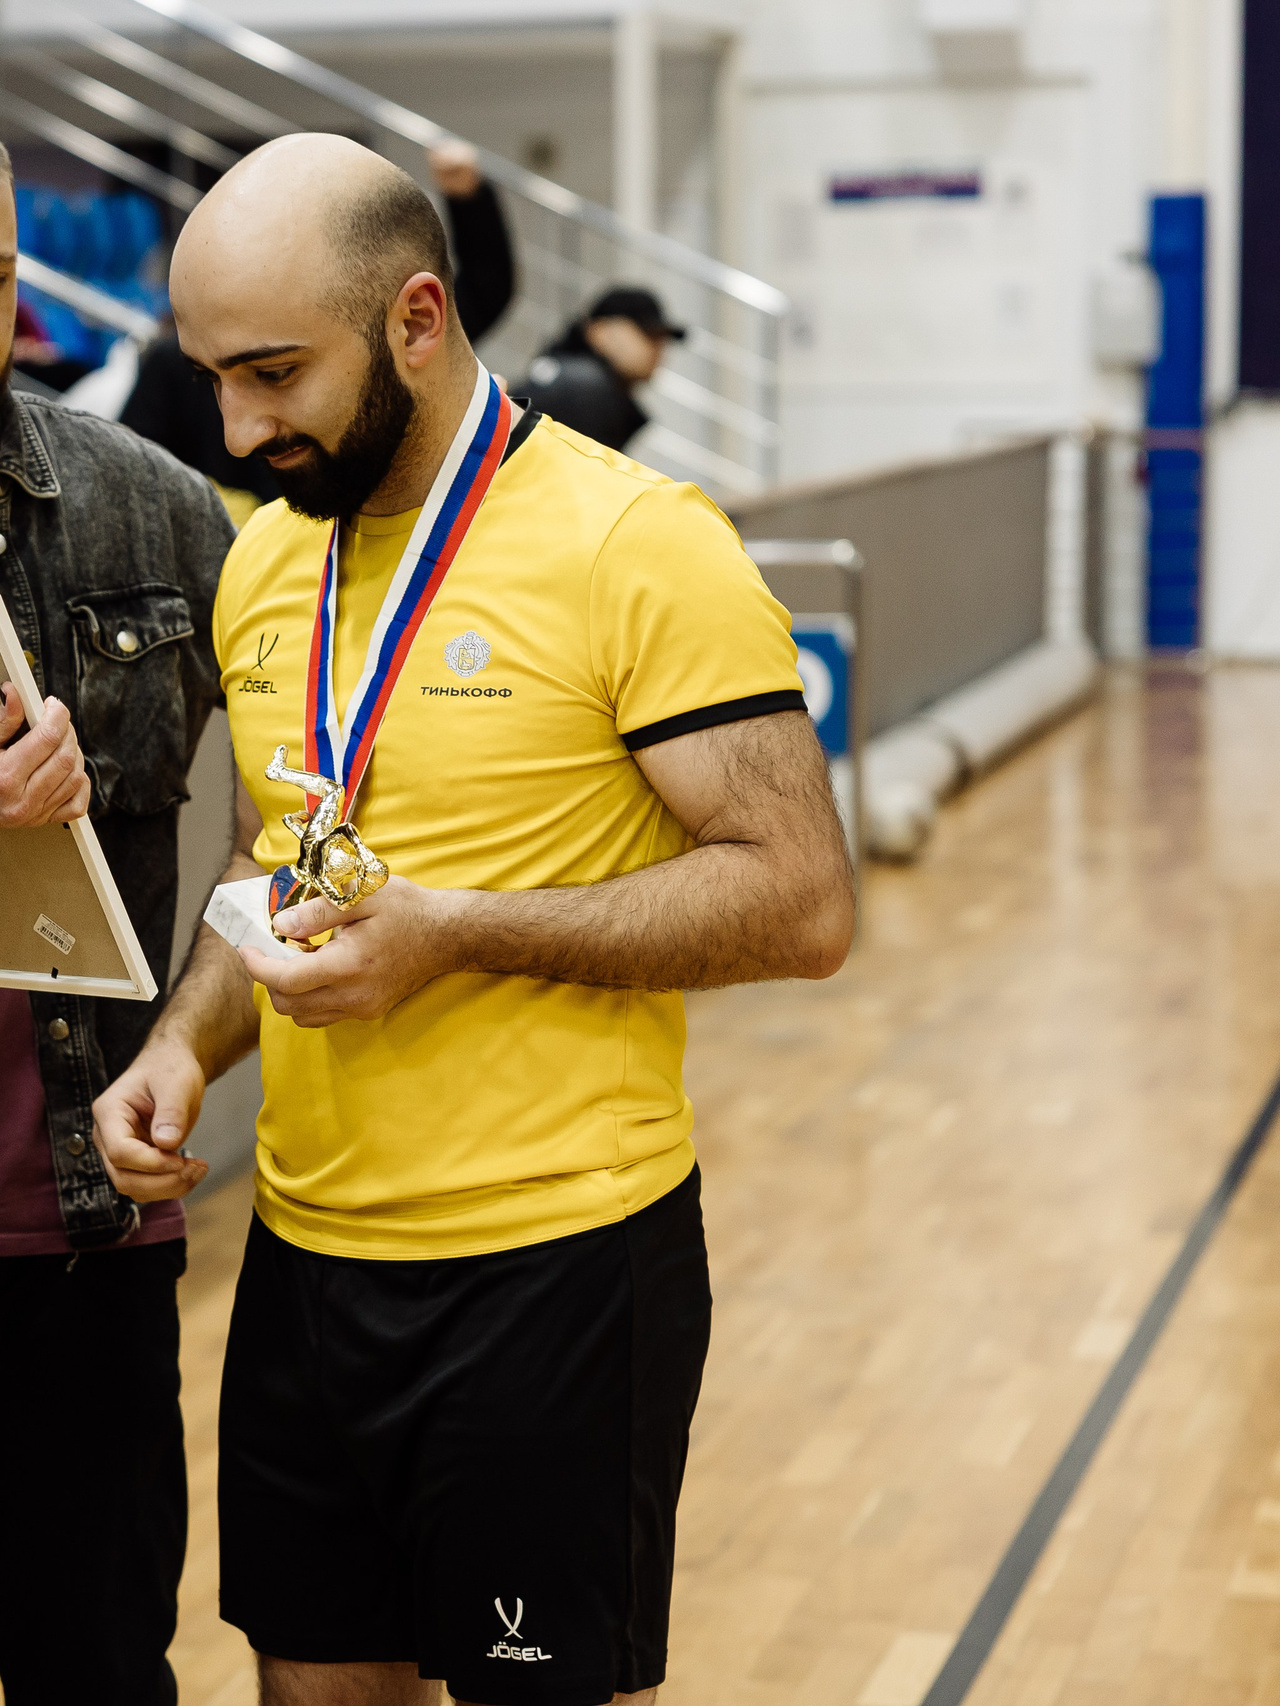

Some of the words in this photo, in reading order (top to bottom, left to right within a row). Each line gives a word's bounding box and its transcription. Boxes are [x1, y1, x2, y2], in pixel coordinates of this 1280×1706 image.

[238, 675, 277, 694] JÖGEL
[420, 686, 513, 698] ТИНЬКОФФ
[486, 1641, 552, 1661] JÖGEL
